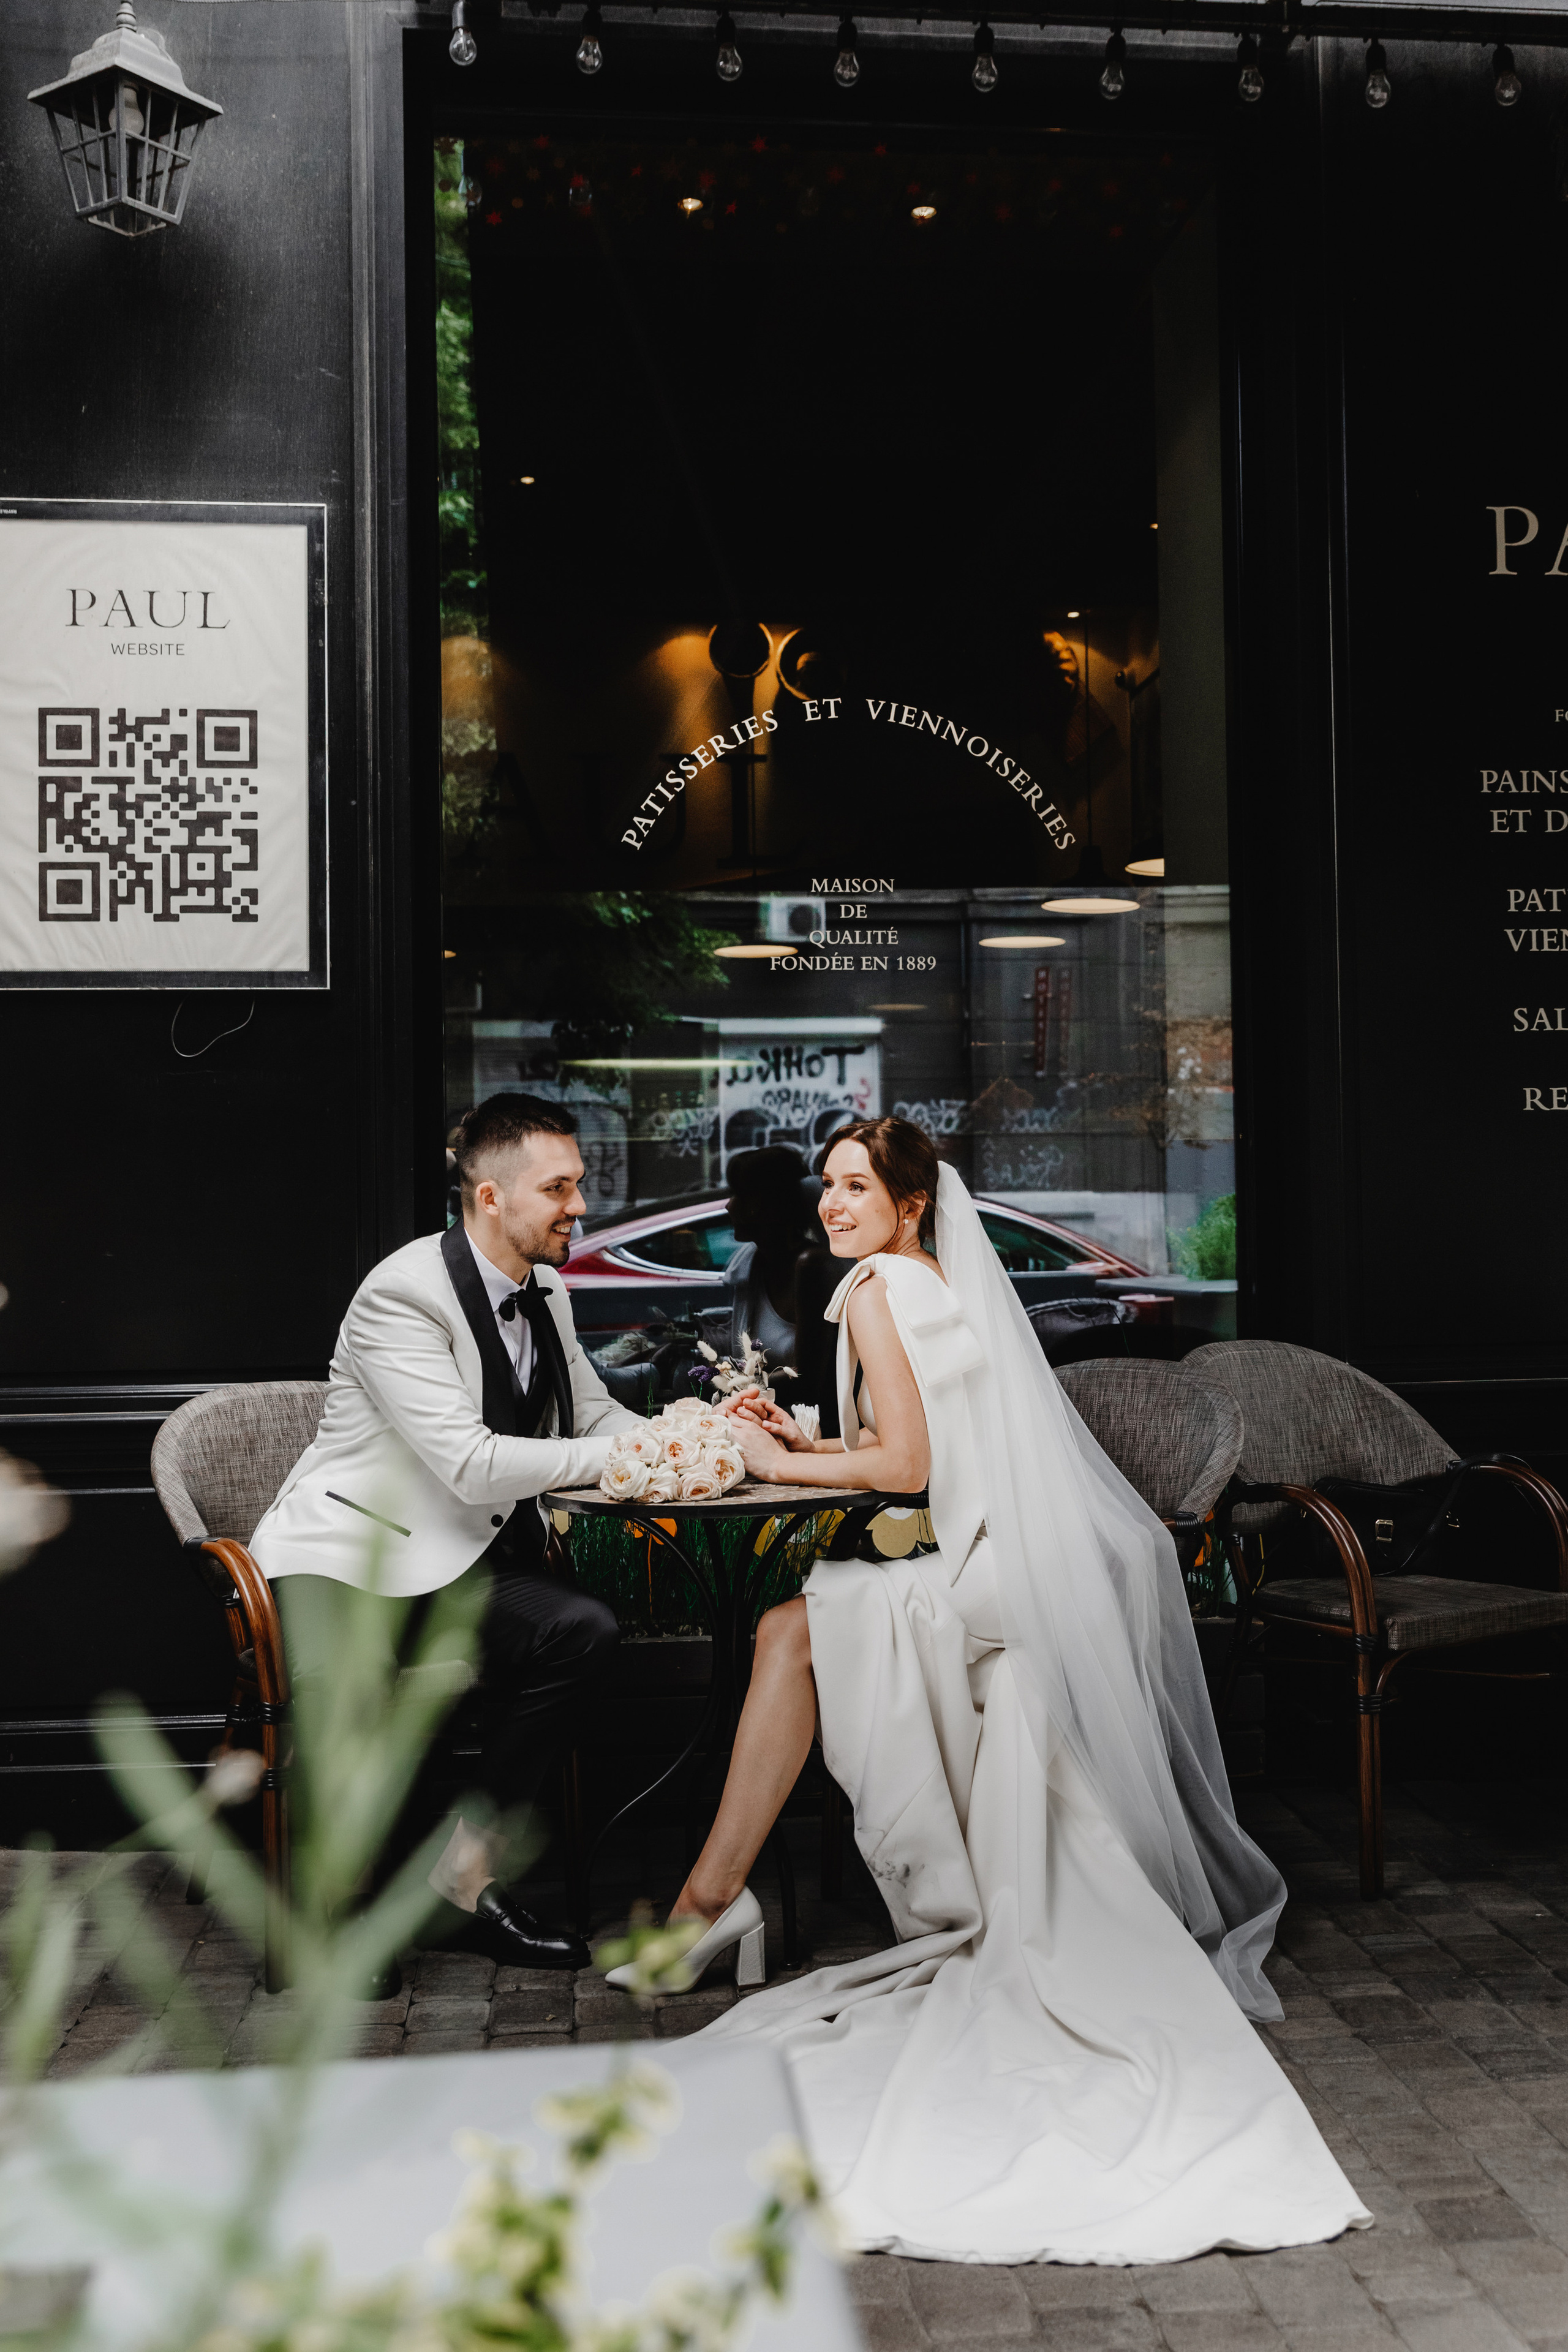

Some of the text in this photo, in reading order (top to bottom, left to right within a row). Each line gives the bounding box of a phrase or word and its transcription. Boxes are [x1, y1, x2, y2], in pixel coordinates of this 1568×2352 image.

[66, 589, 230, 629] PAUL
[111, 643, 185, 655] WEBSITE
[621, 698, 1076, 850] PATISSERIES ET VIENNOISERIES
[1490, 809, 1532, 833] ET
[811, 878, 894, 892] MAISON
[1507, 888, 1568, 912] PAT
[840, 905, 867, 918] DE
[809, 926, 899, 948] QUALITÉ
[770, 951, 937, 970] FONDÉE EN 1889
